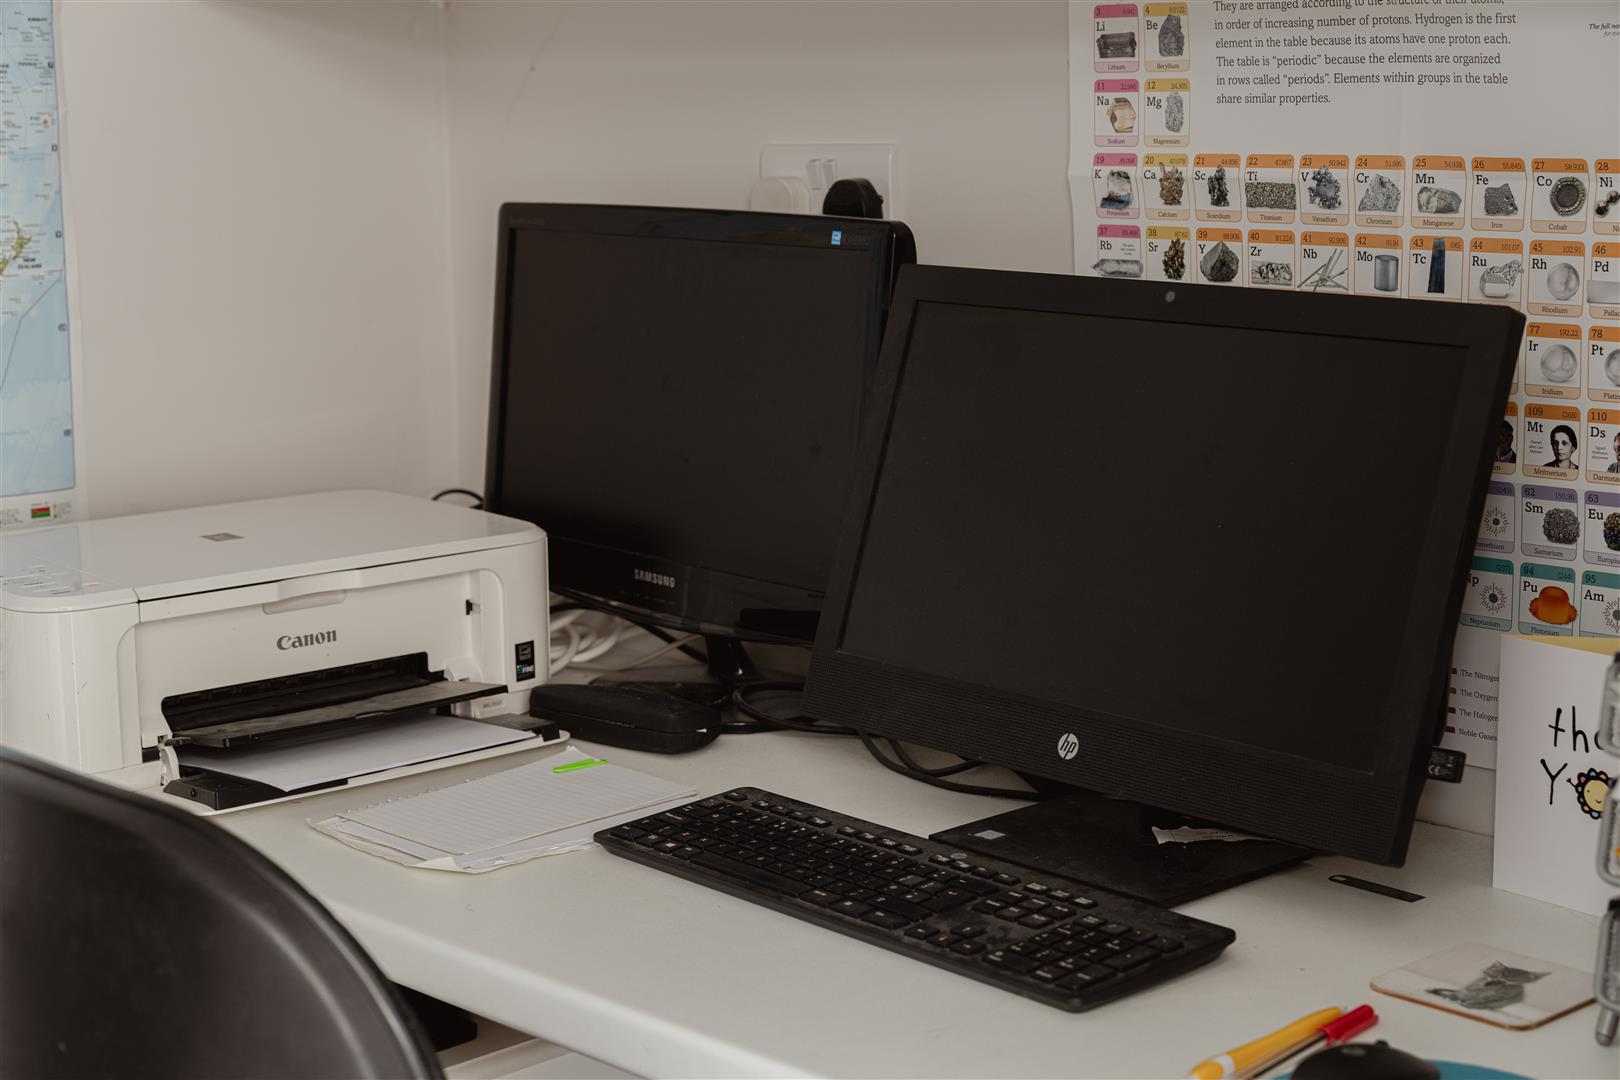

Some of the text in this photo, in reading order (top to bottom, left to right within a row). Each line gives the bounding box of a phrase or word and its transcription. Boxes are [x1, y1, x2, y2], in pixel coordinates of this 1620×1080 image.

[1145, 6, 1150, 14] 4
[1213, 1, 1237, 13] They
[1240, 2, 1254, 10] are
[1256, 0, 1299, 12] arranged
[1302, 0, 1352, 9] according
[1096, 21, 1105, 31] Li
[1146, 20, 1158, 30] Be
[1214, 12, 1517, 30] in order of increasing number of protons. Hydrogen is the first
[1216, 32, 1511, 48] element in the table because its atoms have one proton each.
[1216, 56, 1235, 67] The
[1237, 56, 1260, 67] table
[1262, 56, 1270, 66] is
[1324, 54, 1366, 65] because
[1368, 52, 1385, 64] the
[1388, 52, 1432, 64] elements
[1434, 54, 1450, 64] are
[1452, 53, 1502, 66] organized
[1216, 74, 1225, 85] in
[1228, 76, 1250, 85] rows
[1253, 74, 1280, 85] called
[1334, 72, 1380, 84] Elements
[1383, 72, 1414, 83] within
[1417, 74, 1450, 86] groups
[1453, 72, 1462, 83] in
[1465, 72, 1481, 84] the
[1483, 72, 1508, 84] table
[1096, 82, 1105, 90] 11
[1147, 81, 1156, 90] 12
[1096, 96, 1110, 106] Na
[1146, 96, 1162, 109] Mg
[1216, 92, 1331, 106] share similar properties.
[1096, 156, 1104, 165] 19
[1145, 156, 1154, 165] 20
[1196, 156, 1205, 165] 21
[1249, 158, 1258, 166] 22
[1302, 158, 1312, 166] 23
[1358, 158, 1368, 167] 24
[1416, 159, 1426, 168] 25
[1474, 160, 1485, 169] 26
[1534, 162, 1545, 170] 27
[1598, 162, 1609, 171] 28
[1094, 169, 1102, 179] K
[1144, 170, 1156, 180] Ca
[1194, 170, 1206, 181] Sc
[1247, 172, 1257, 181] Ti
[1302, 172, 1309, 182] V
[1356, 173, 1369, 183] Cr
[1415, 174, 1435, 184] Mn
[1476, 175, 1489, 185] Fe
[1536, 176, 1552, 187] Co
[1600, 176, 1613, 188] Ni
[1548, 223, 1568, 231] Cobalt
[1148, 228, 1157, 237] 38
[1198, 230, 1208, 238] 39
[1250, 232, 1260, 241] 40
[1303, 234, 1312, 243] 41
[1358, 236, 1367, 246] 42
[1414, 239, 1424, 248] 43
[1100, 240, 1112, 250] Rb
[1148, 242, 1158, 252] Sr
[1198, 244, 1206, 254] Y
[1472, 241, 1483, 250] 44
[1532, 243, 1544, 252] 45
[1250, 246, 1262, 256] Zr
[1303, 249, 1318, 259] Nb
[1595, 246, 1606, 255] 46
[1357, 252, 1373, 262] Mo
[1413, 253, 1426, 264] Tc
[1472, 256, 1488, 267] Ru
[1532, 259, 1547, 270] Rh
[1594, 261, 1609, 273] Pd
[1542, 306, 1568, 314] Rhodium
[1529, 326, 1540, 334] 77
[1592, 329, 1603, 338] 78
[1529, 340, 1539, 352] Ir
[1592, 344, 1604, 356] Pt
[1528, 407, 1544, 416] 109
[1592, 412, 1607, 422] 110
[1528, 421, 1544, 433] Mt
[1590, 426, 1606, 438] Ds
[1525, 488, 1536, 497] 62
[1588, 495, 1599, 504] 63
[1525, 503, 1544, 514] Sm
[1588, 509, 1604, 521] Eu
[1523, 566, 1534, 576] 94
[634, 568, 676, 588] SAMSUNG
[1585, 574, 1596, 584] 95
[1523, 581, 1538, 593] Pu
[1584, 590, 1604, 602] Am
[276, 630, 338, 650] Canon
[1460, 669, 1473, 678] The
[1460, 688, 1498, 702] The Oxygen
[1459, 708, 1472, 717] The
[1459, 728, 1498, 742] Noble Gases
[1058, 733, 1079, 760] hp
